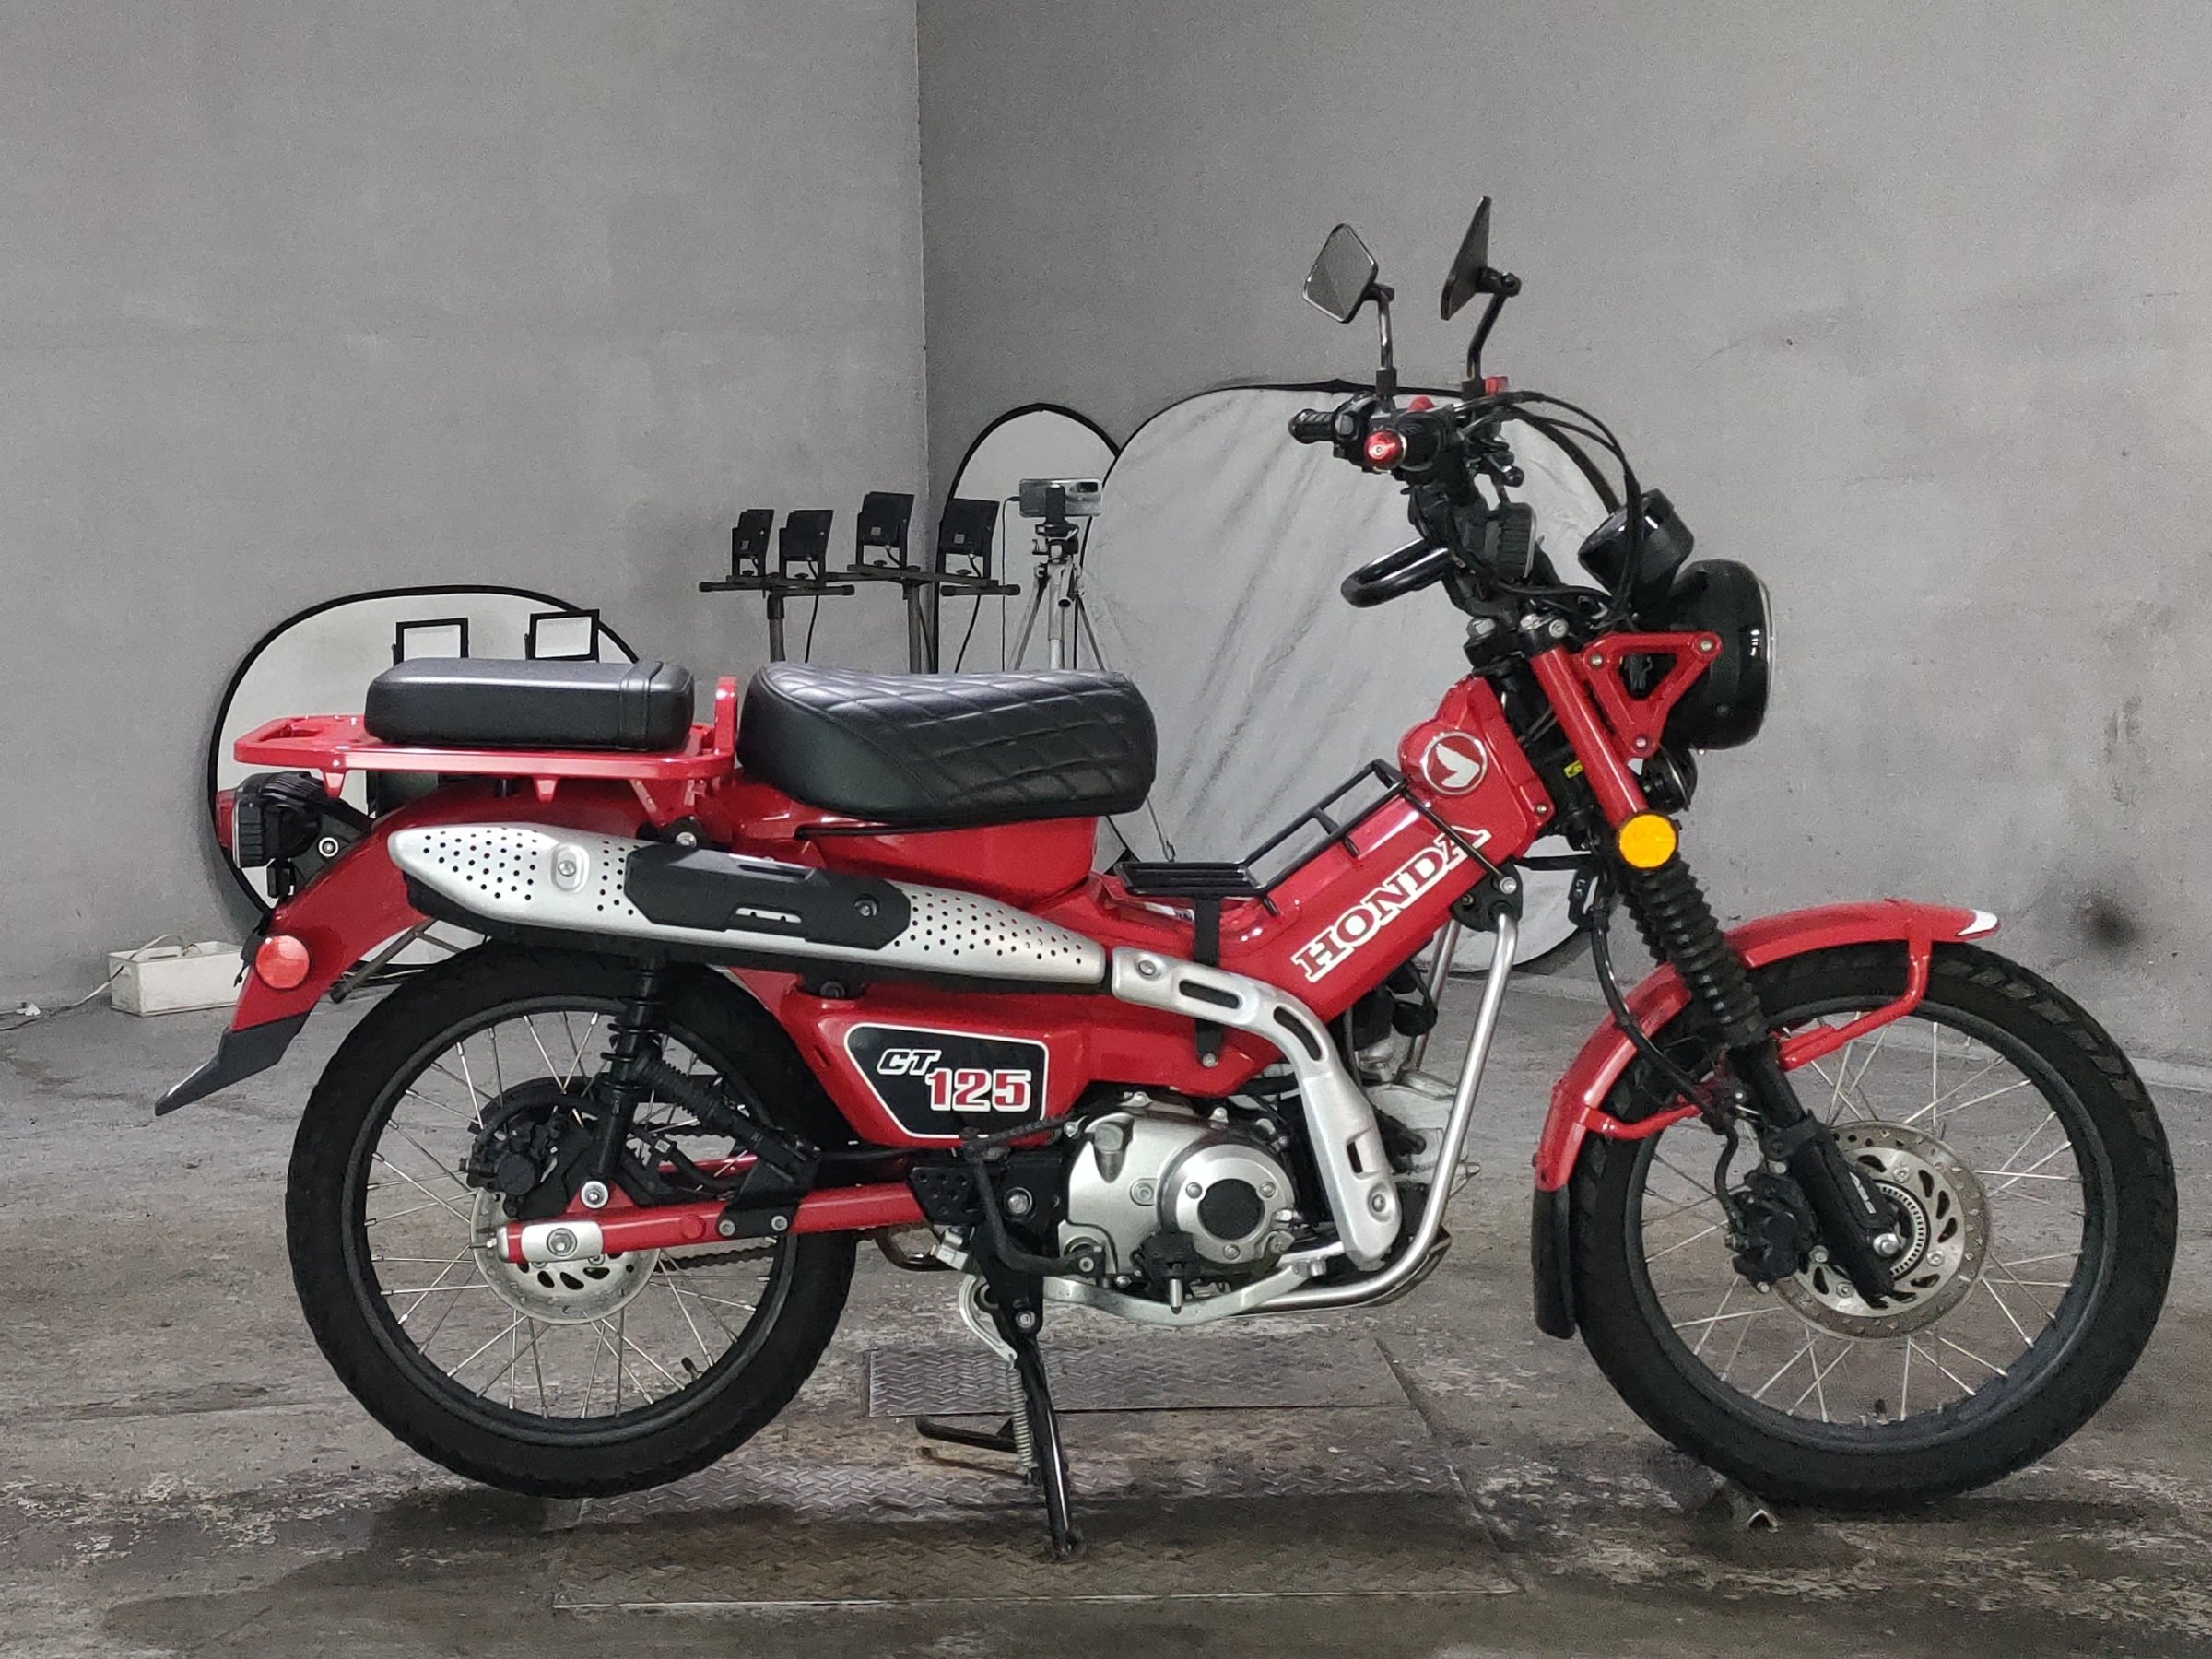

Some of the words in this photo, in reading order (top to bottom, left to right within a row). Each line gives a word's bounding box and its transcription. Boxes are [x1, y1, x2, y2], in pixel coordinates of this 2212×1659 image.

[1290, 825, 1493, 983] HONDA
[877, 1048, 942, 1076] CT
[924, 1067, 1032, 1112] 125
